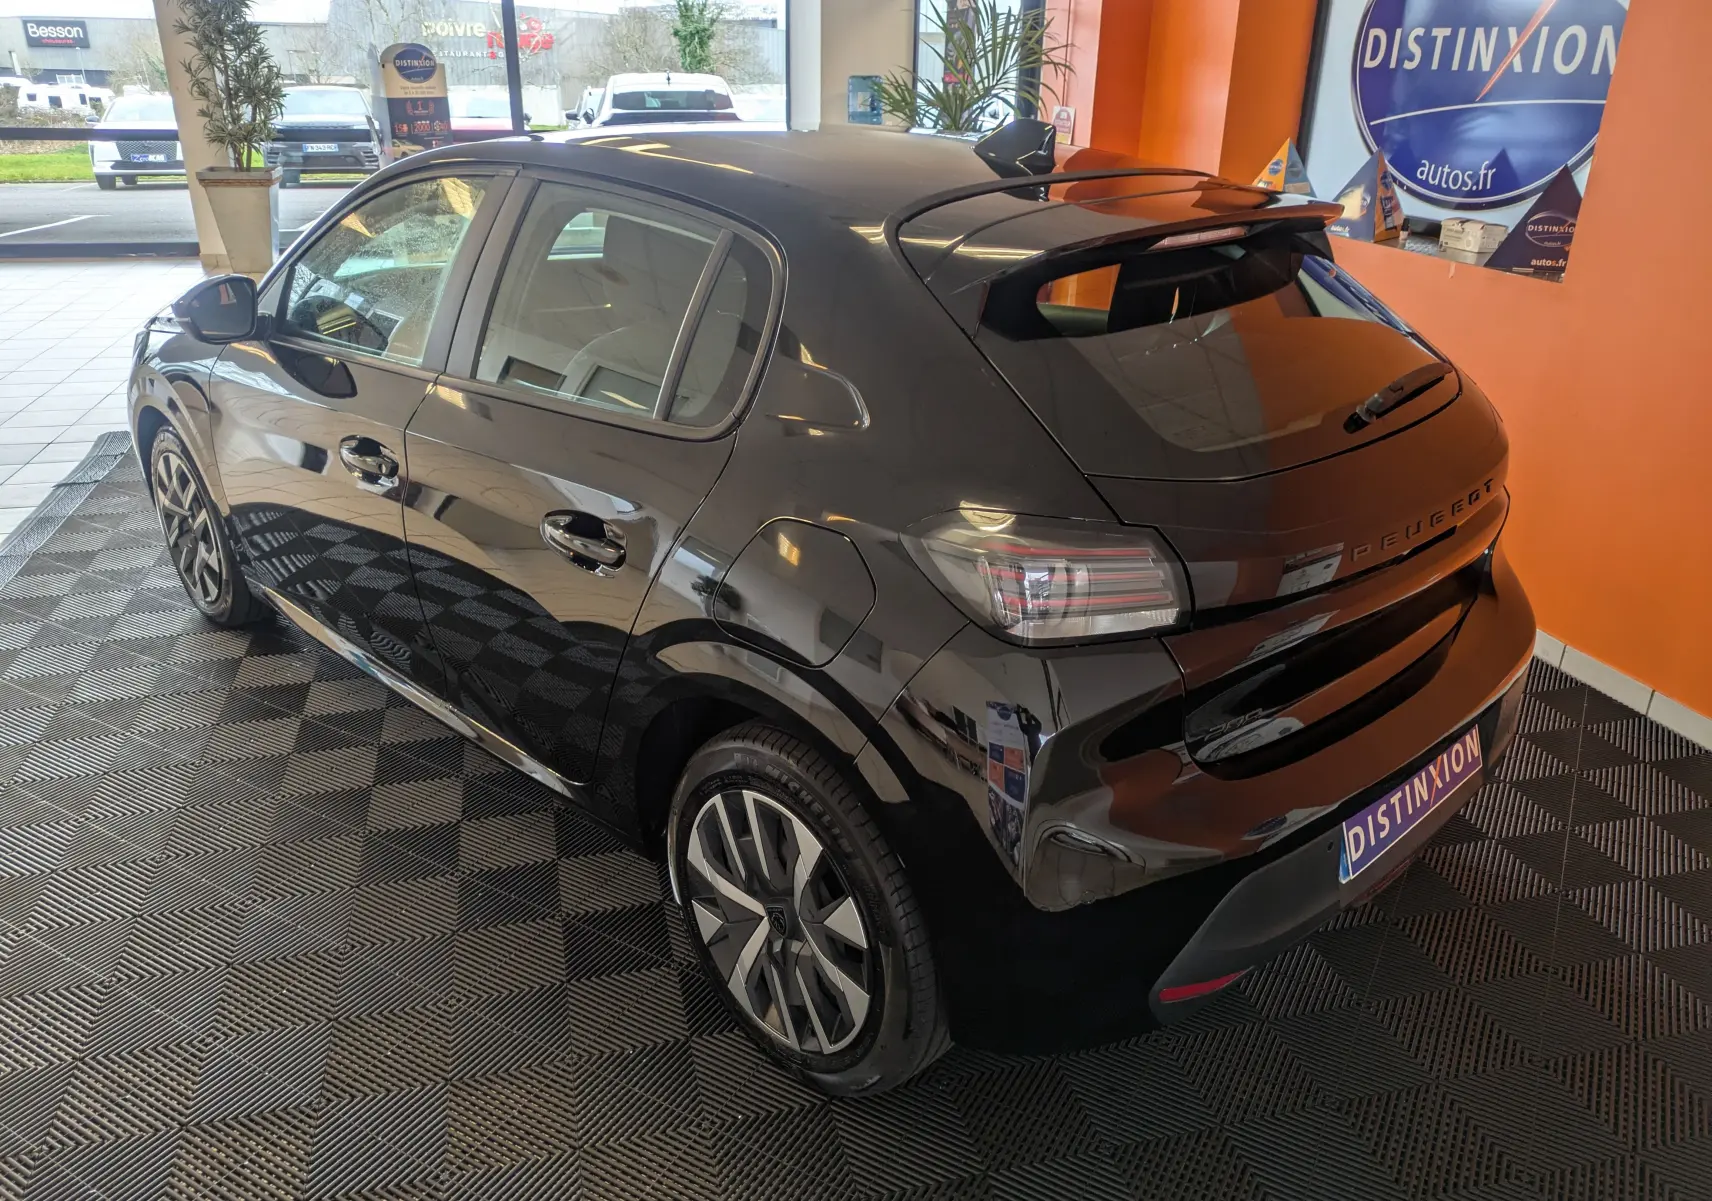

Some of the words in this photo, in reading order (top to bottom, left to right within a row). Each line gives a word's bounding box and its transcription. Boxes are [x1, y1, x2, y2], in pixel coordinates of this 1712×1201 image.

[27, 23, 84, 38] Besson
[421, 18, 486, 37] poivre
[1416, 160, 1497, 191] autos.fr
[1531, 258, 1567, 267] autos.fr
[1352, 479, 1494, 562] PEUGEOT
[1348, 728, 1479, 862] DISTINXION
